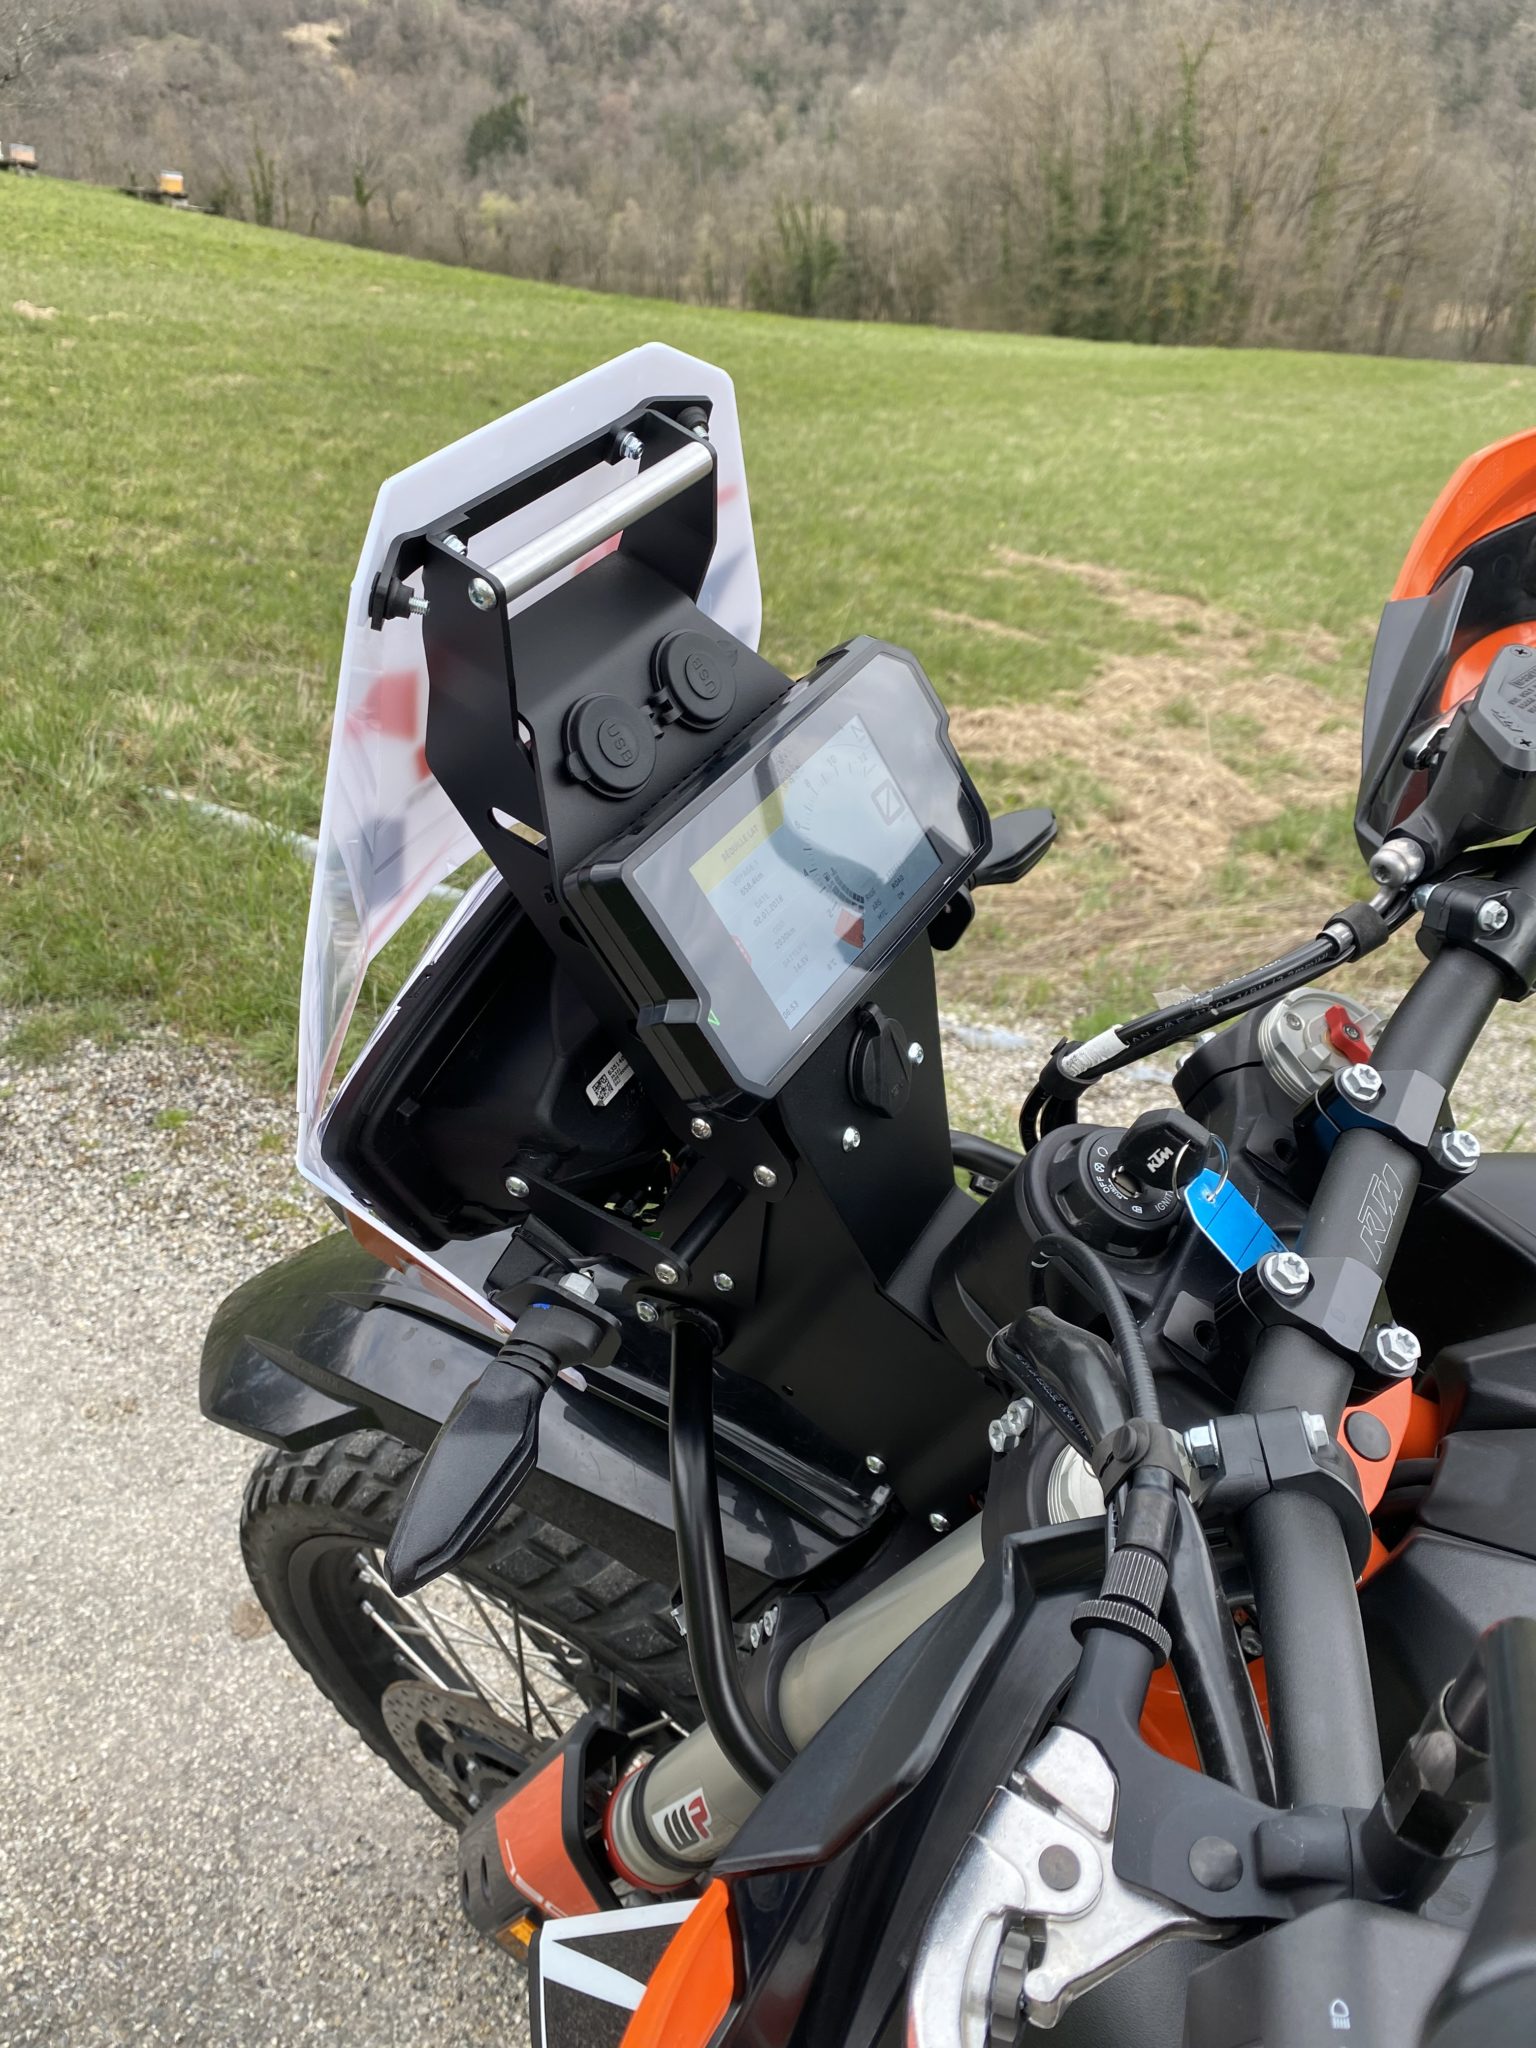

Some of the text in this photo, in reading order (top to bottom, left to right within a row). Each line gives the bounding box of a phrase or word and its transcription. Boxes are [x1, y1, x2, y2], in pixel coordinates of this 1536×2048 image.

[691, 656, 718, 695] USB
[606, 723, 635, 764] USB
[1146, 1146, 1175, 1174] KTM
[1096, 1175, 1111, 1194] OFF
[1154, 1190, 1174, 1213] IGNIT
[1357, 1162, 1404, 1265] KTM
